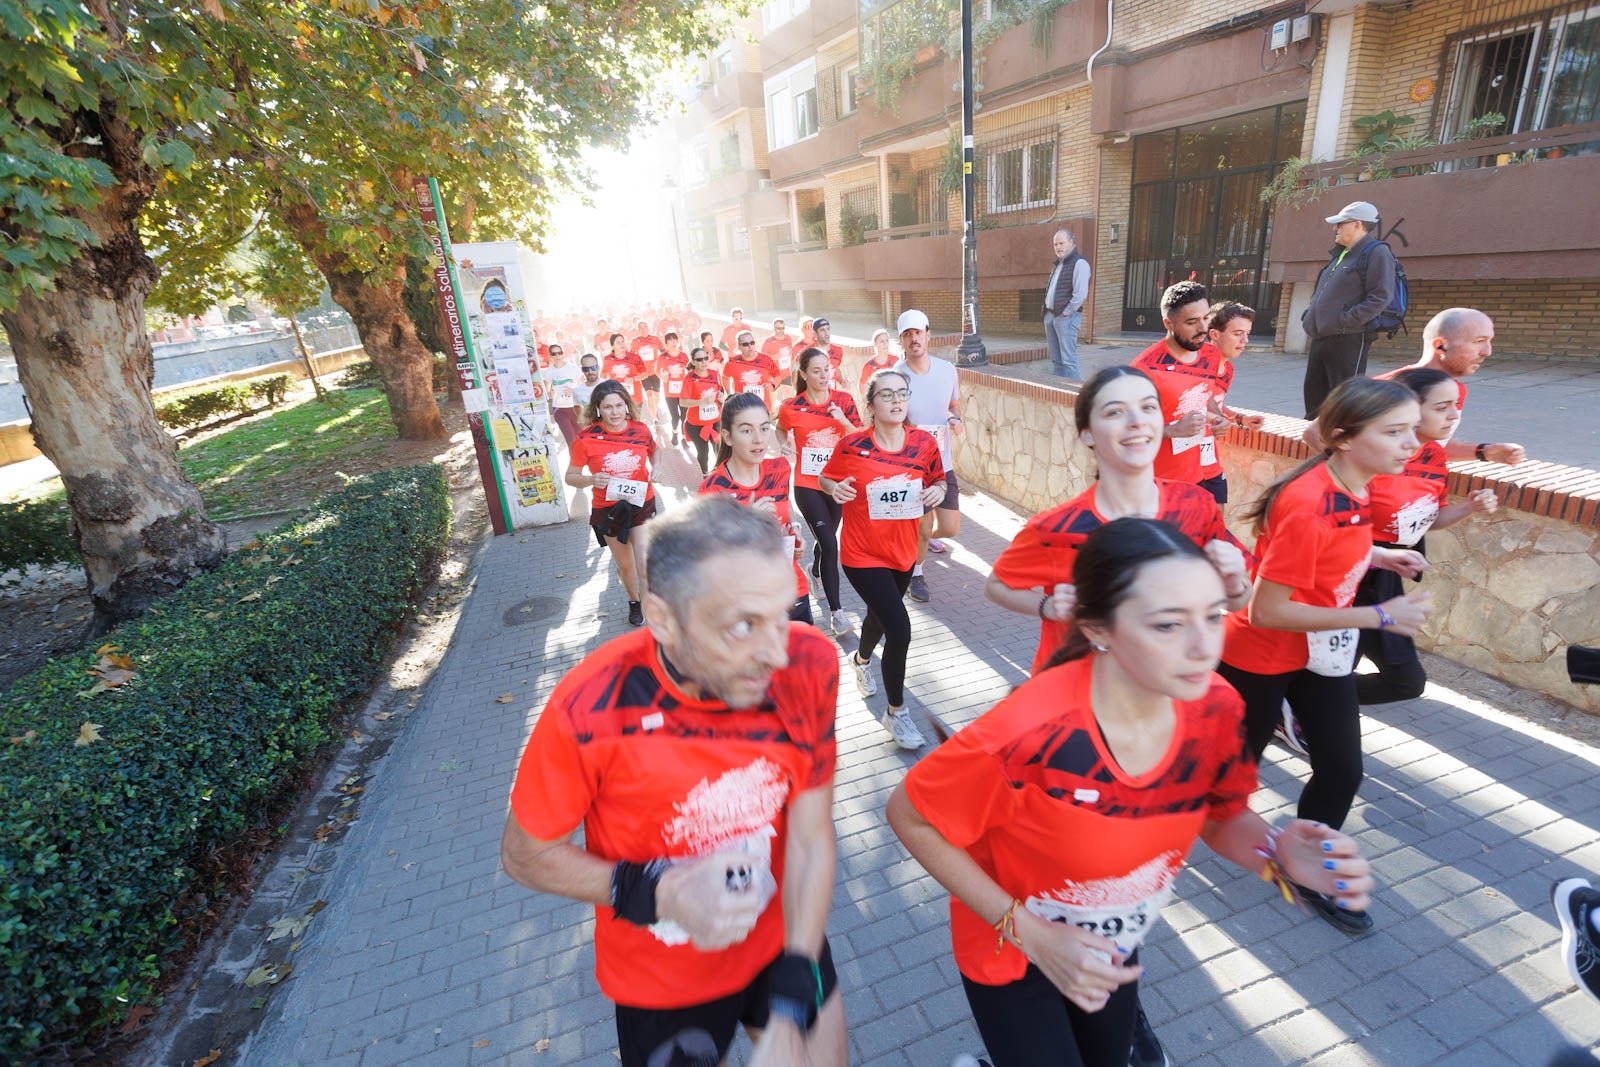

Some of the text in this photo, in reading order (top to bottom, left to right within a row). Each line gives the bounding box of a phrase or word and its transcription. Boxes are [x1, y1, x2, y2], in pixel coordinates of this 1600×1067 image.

[810, 453, 829, 463] 764
[617, 484, 637, 495] 125
[880, 490, 908, 503] 487
